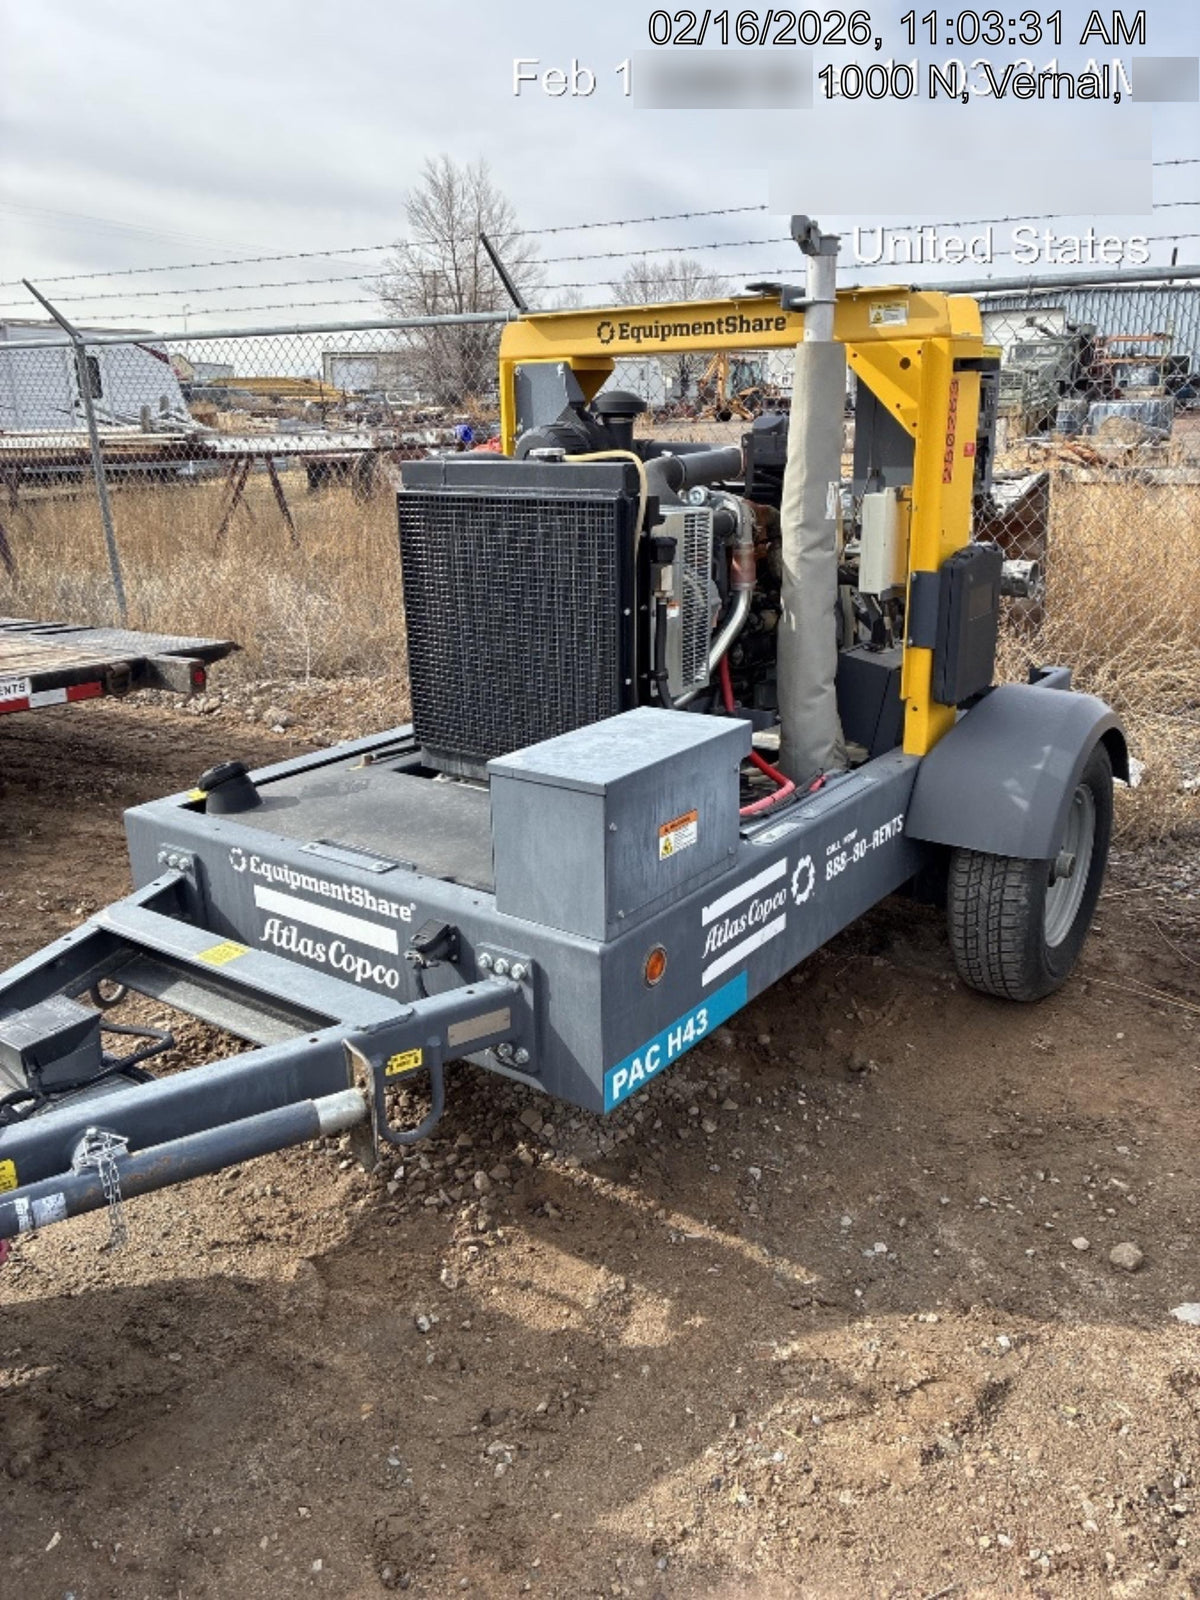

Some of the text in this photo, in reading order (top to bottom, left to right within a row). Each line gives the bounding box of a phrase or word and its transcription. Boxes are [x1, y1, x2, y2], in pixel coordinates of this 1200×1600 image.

[618, 314, 787, 343] EquipmentShare
[826, 813, 904, 881] 888-80-RENTS
[250, 855, 412, 922] EquipmentShare
[259, 918, 326, 963] Atlas
[328, 940, 399, 989] Copco
[701, 888, 787, 959] Atlas Copco
[612, 1008, 709, 1101] PAC H43
